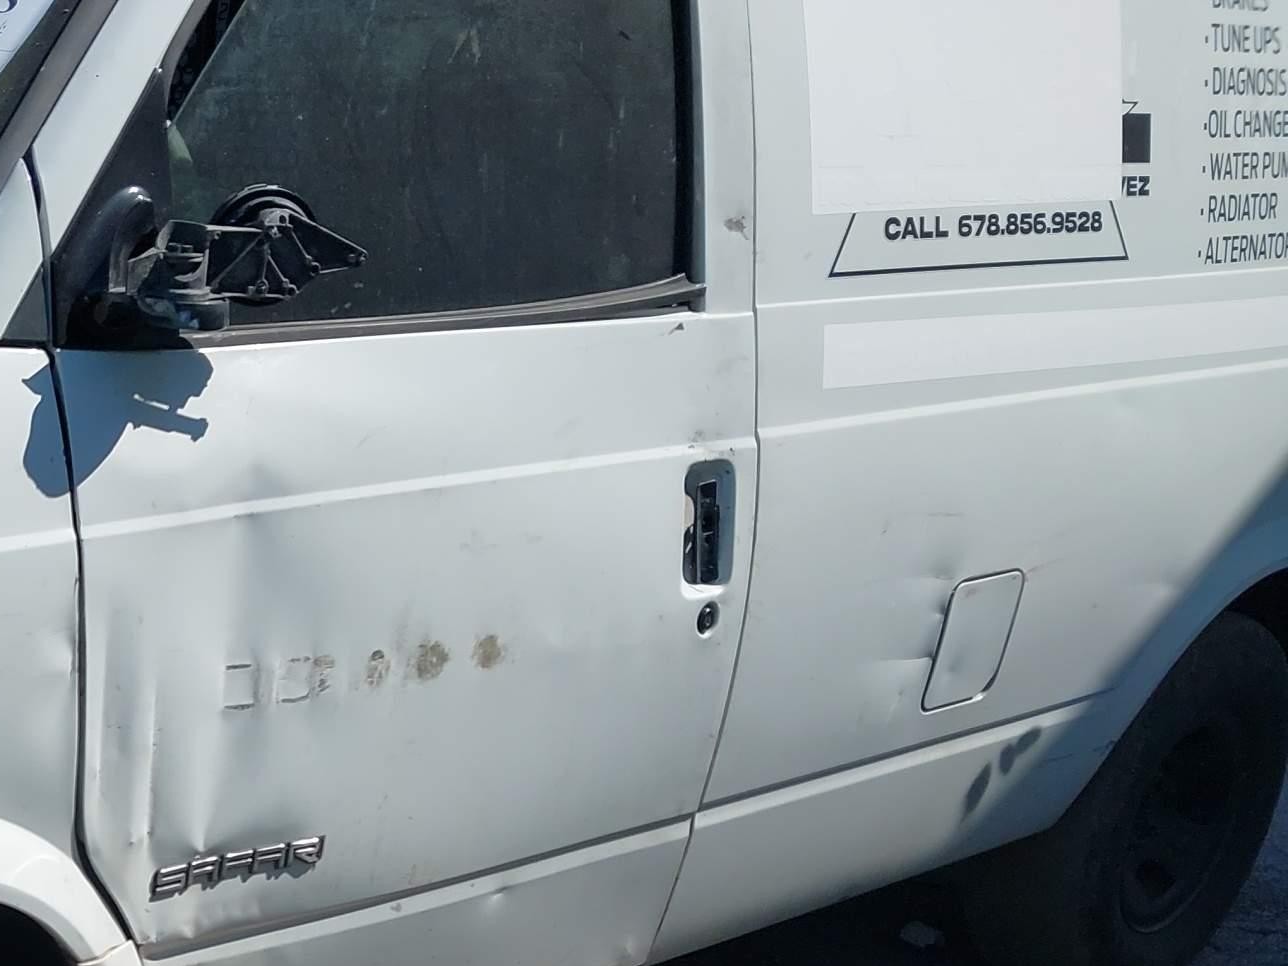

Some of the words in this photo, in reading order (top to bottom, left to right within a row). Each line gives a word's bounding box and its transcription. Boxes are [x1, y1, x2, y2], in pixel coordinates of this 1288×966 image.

[1211, 23, 1250, 52] TUNE
[1253, 25, 1281, 54] UPS
[1212, 66, 1288, 96] DIAGNOSIS
[1208, 110, 1231, 138] OIL
[1234, 110, 1288, 138] CHANGE
[1210, 152, 1259, 180] WATER
[1208, 192, 1278, 223] RADIATOR
[884, 215, 950, 240] CALL
[958, 210, 1103, 237] 678.856.9528
